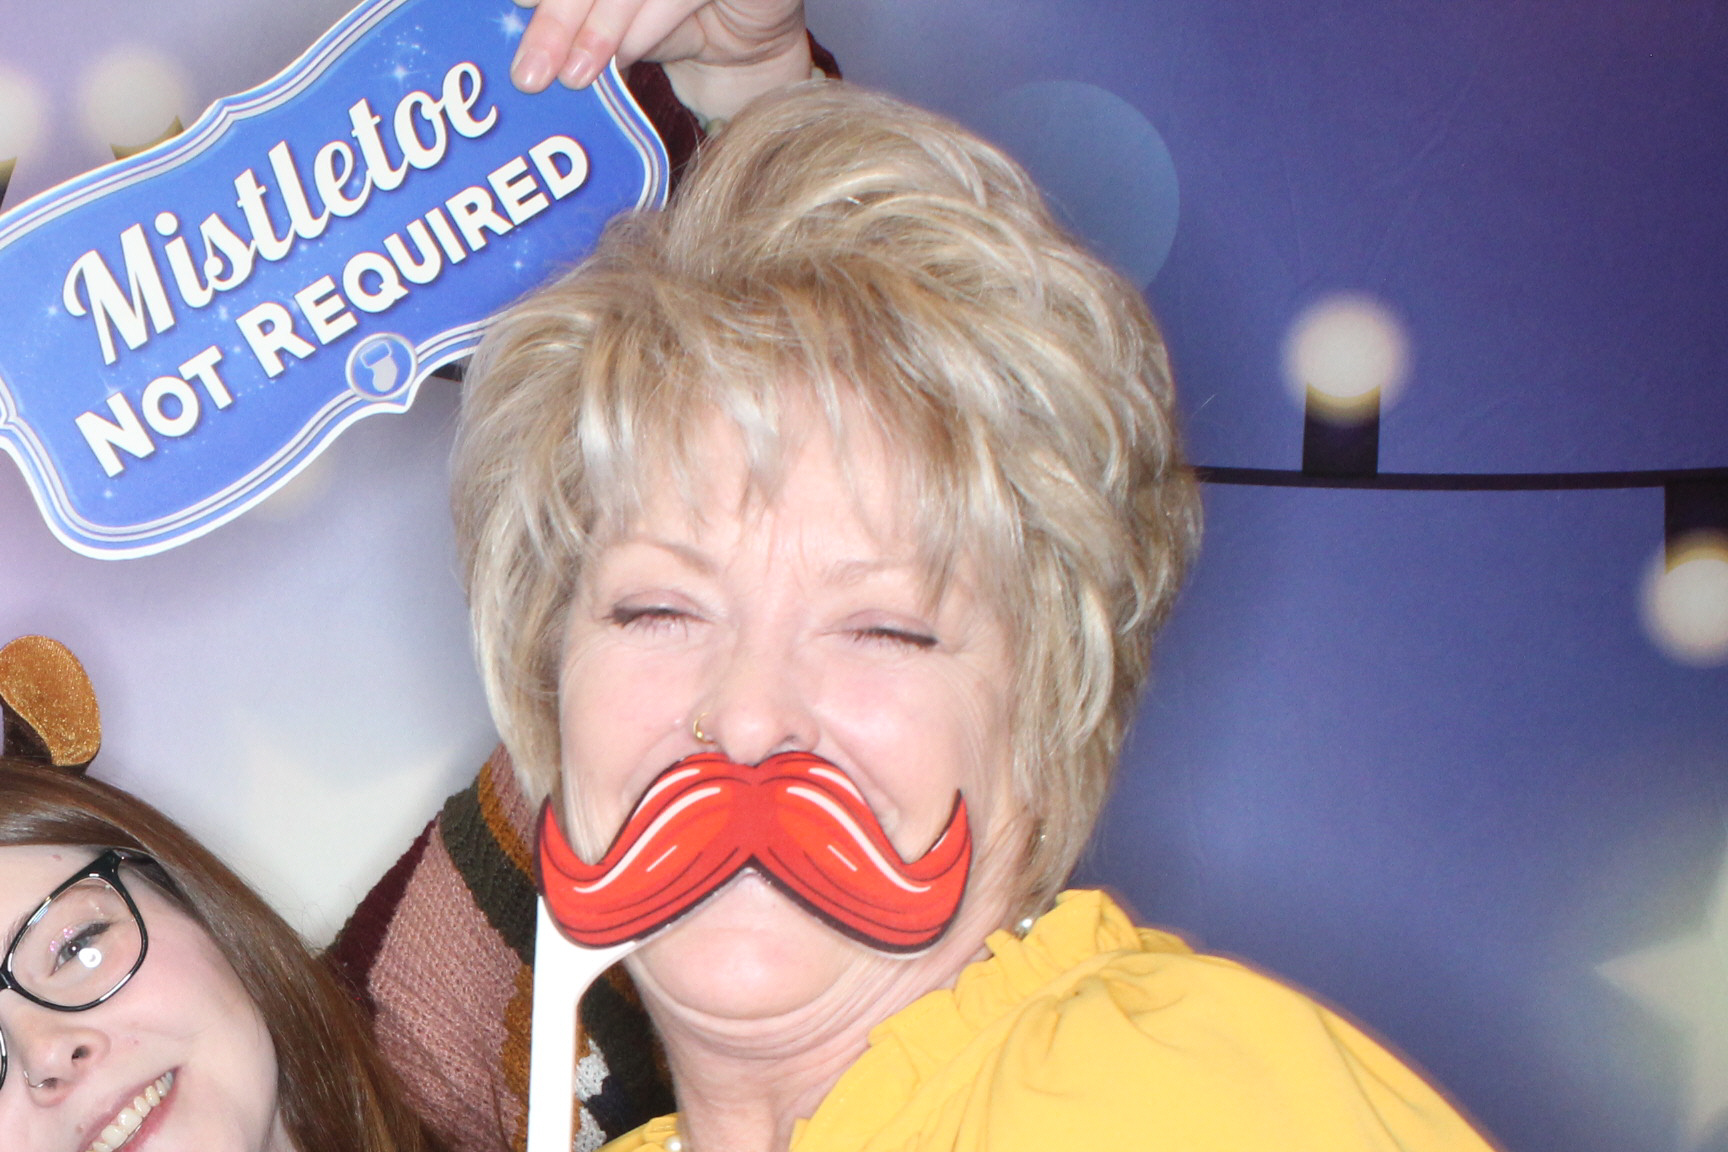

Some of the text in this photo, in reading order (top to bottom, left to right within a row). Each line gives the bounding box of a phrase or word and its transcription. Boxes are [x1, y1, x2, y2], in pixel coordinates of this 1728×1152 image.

[62, 61, 499, 366] Mistletoe
[75, 135, 590, 478] NOT REQUIRED
